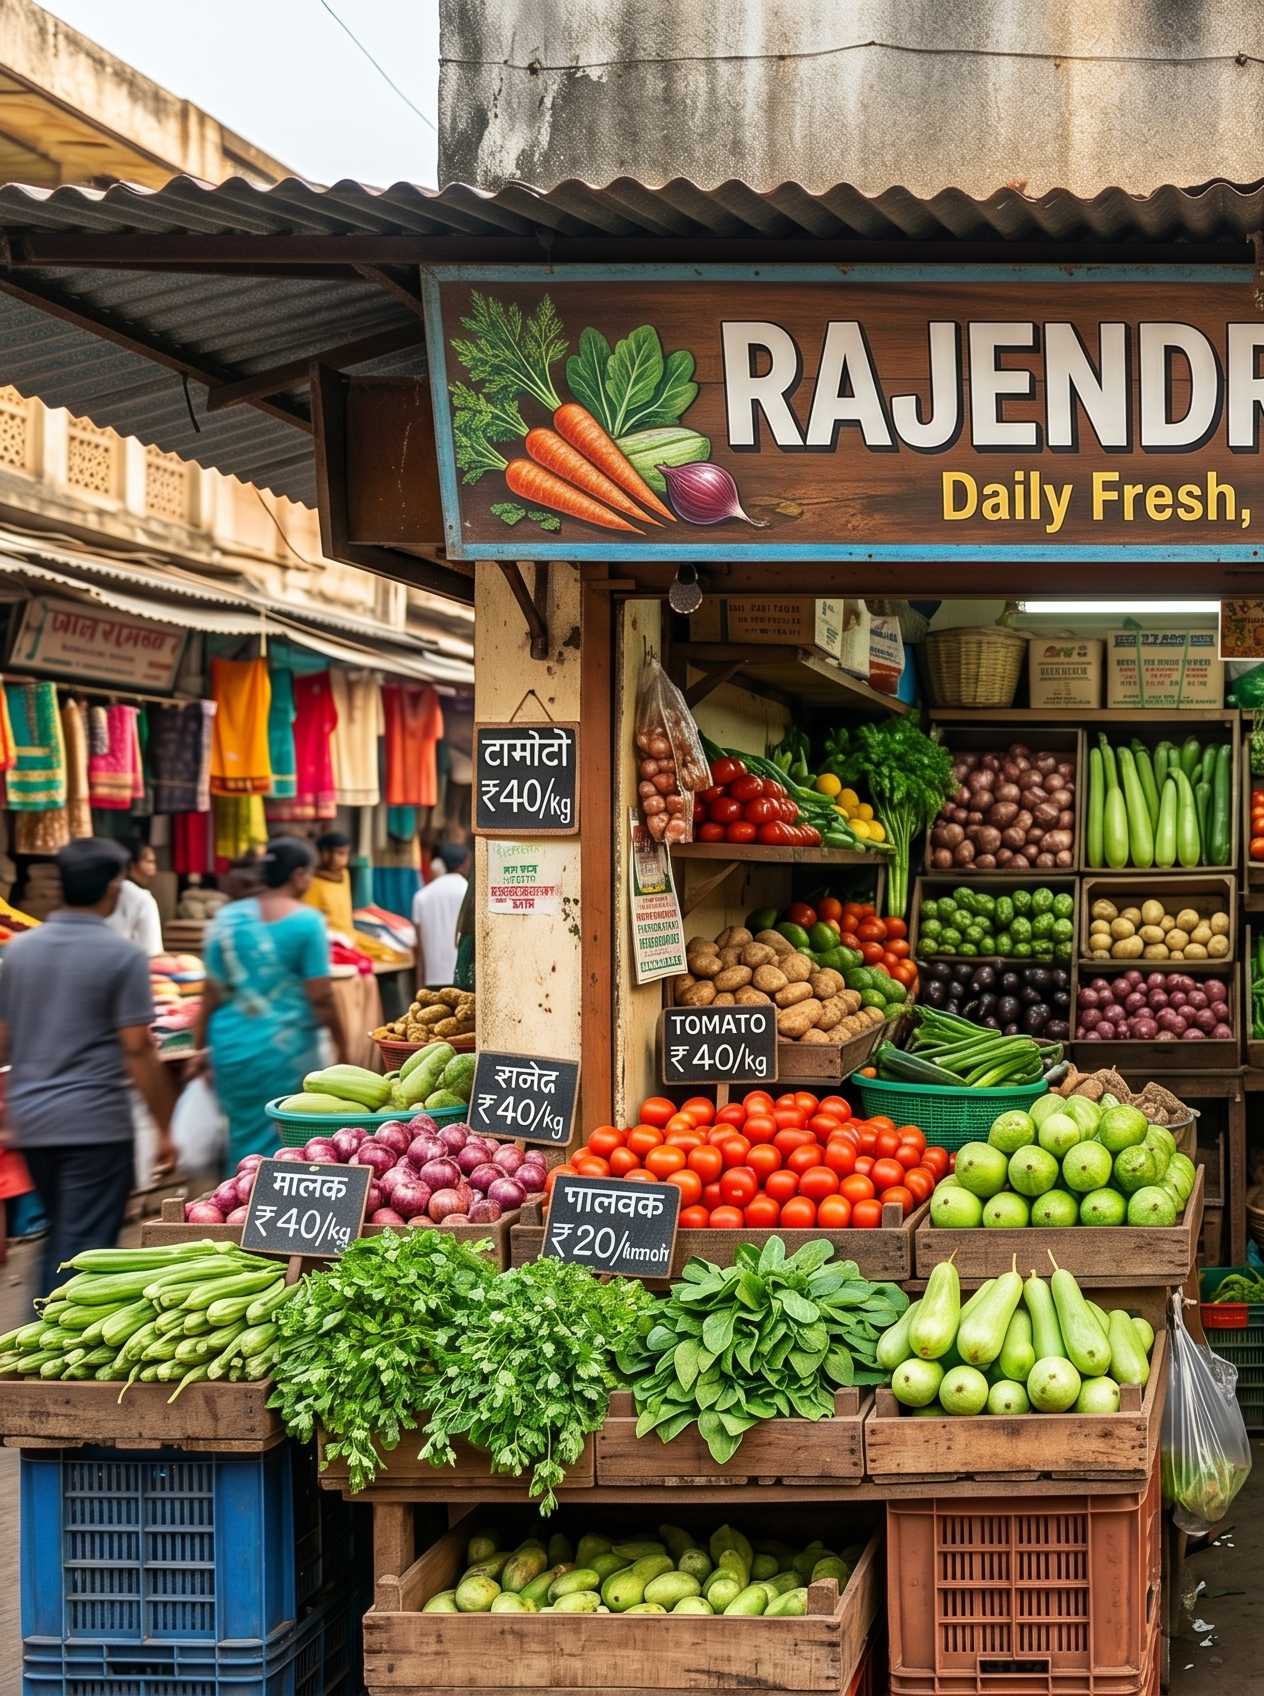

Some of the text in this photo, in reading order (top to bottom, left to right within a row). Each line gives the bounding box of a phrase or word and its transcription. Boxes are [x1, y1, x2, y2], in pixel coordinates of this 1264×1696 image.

[941, 471, 1074, 534] Daily
[1091, 471, 1252, 529] Fresh,
[481, 728, 572, 767] टामोटो
[481, 778, 571, 823] ₹40/kg
[670, 1013, 766, 1035] TOMATO
[670, 1043, 767, 1077] ₹40/kg
[477, 1093, 564, 1139] ₹40/kg
[273, 1172, 349, 1201] मालक
[254, 1205, 351, 1249] ₹40/kg
